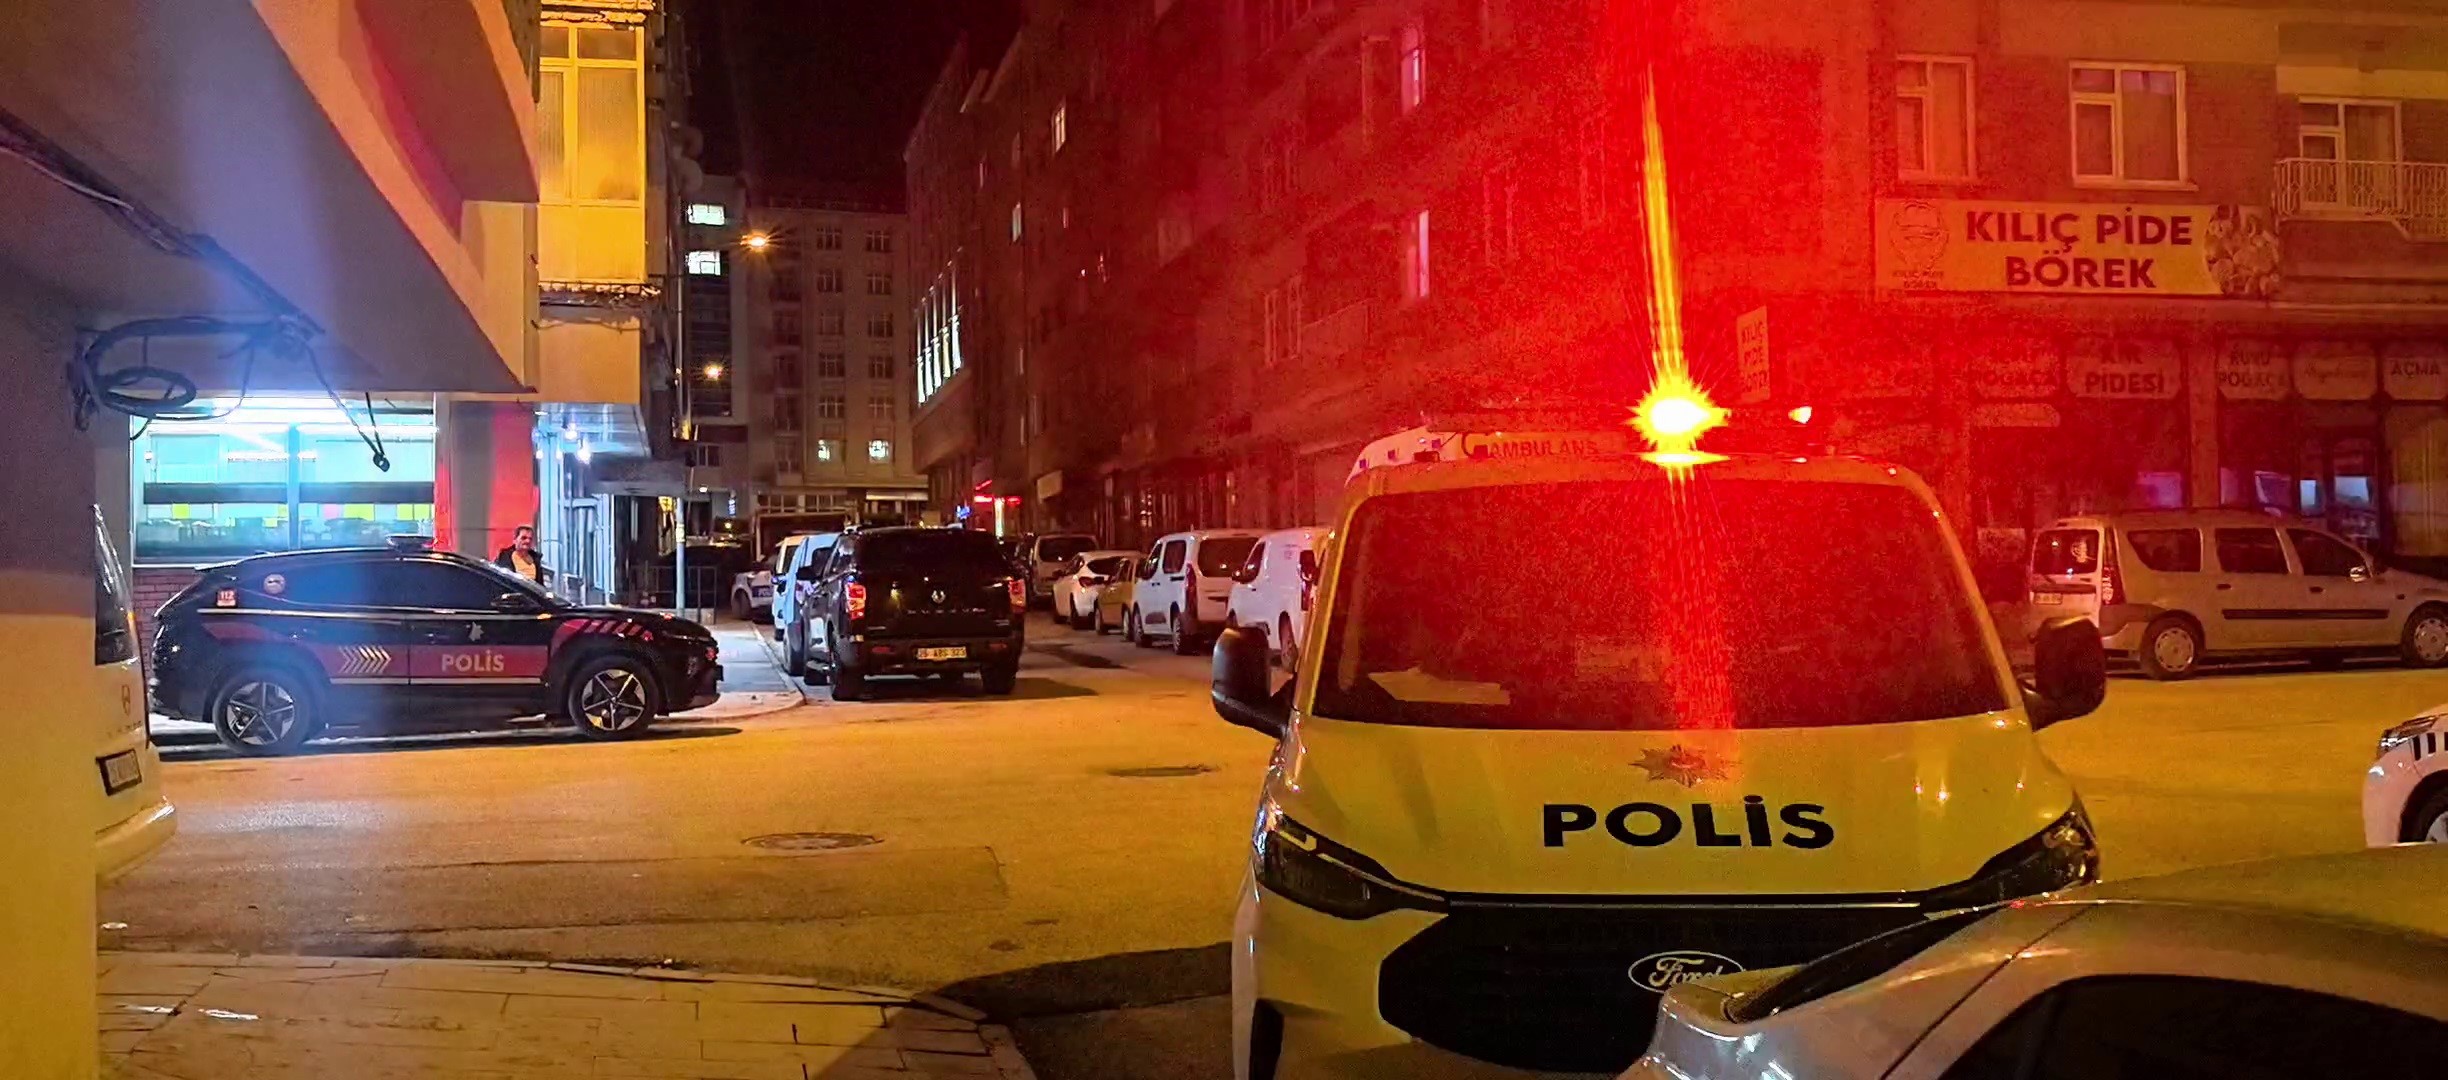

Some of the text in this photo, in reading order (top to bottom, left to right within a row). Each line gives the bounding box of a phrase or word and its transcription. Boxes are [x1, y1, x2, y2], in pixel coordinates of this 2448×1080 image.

[1966, 206, 2192, 253] KILIÇ PİDE
[2005, 249, 2156, 289] BÖREK
[220, 590, 235, 601] 112
[441, 649, 505, 672] POLİS
[1543, 794, 1835, 849] POLİS
